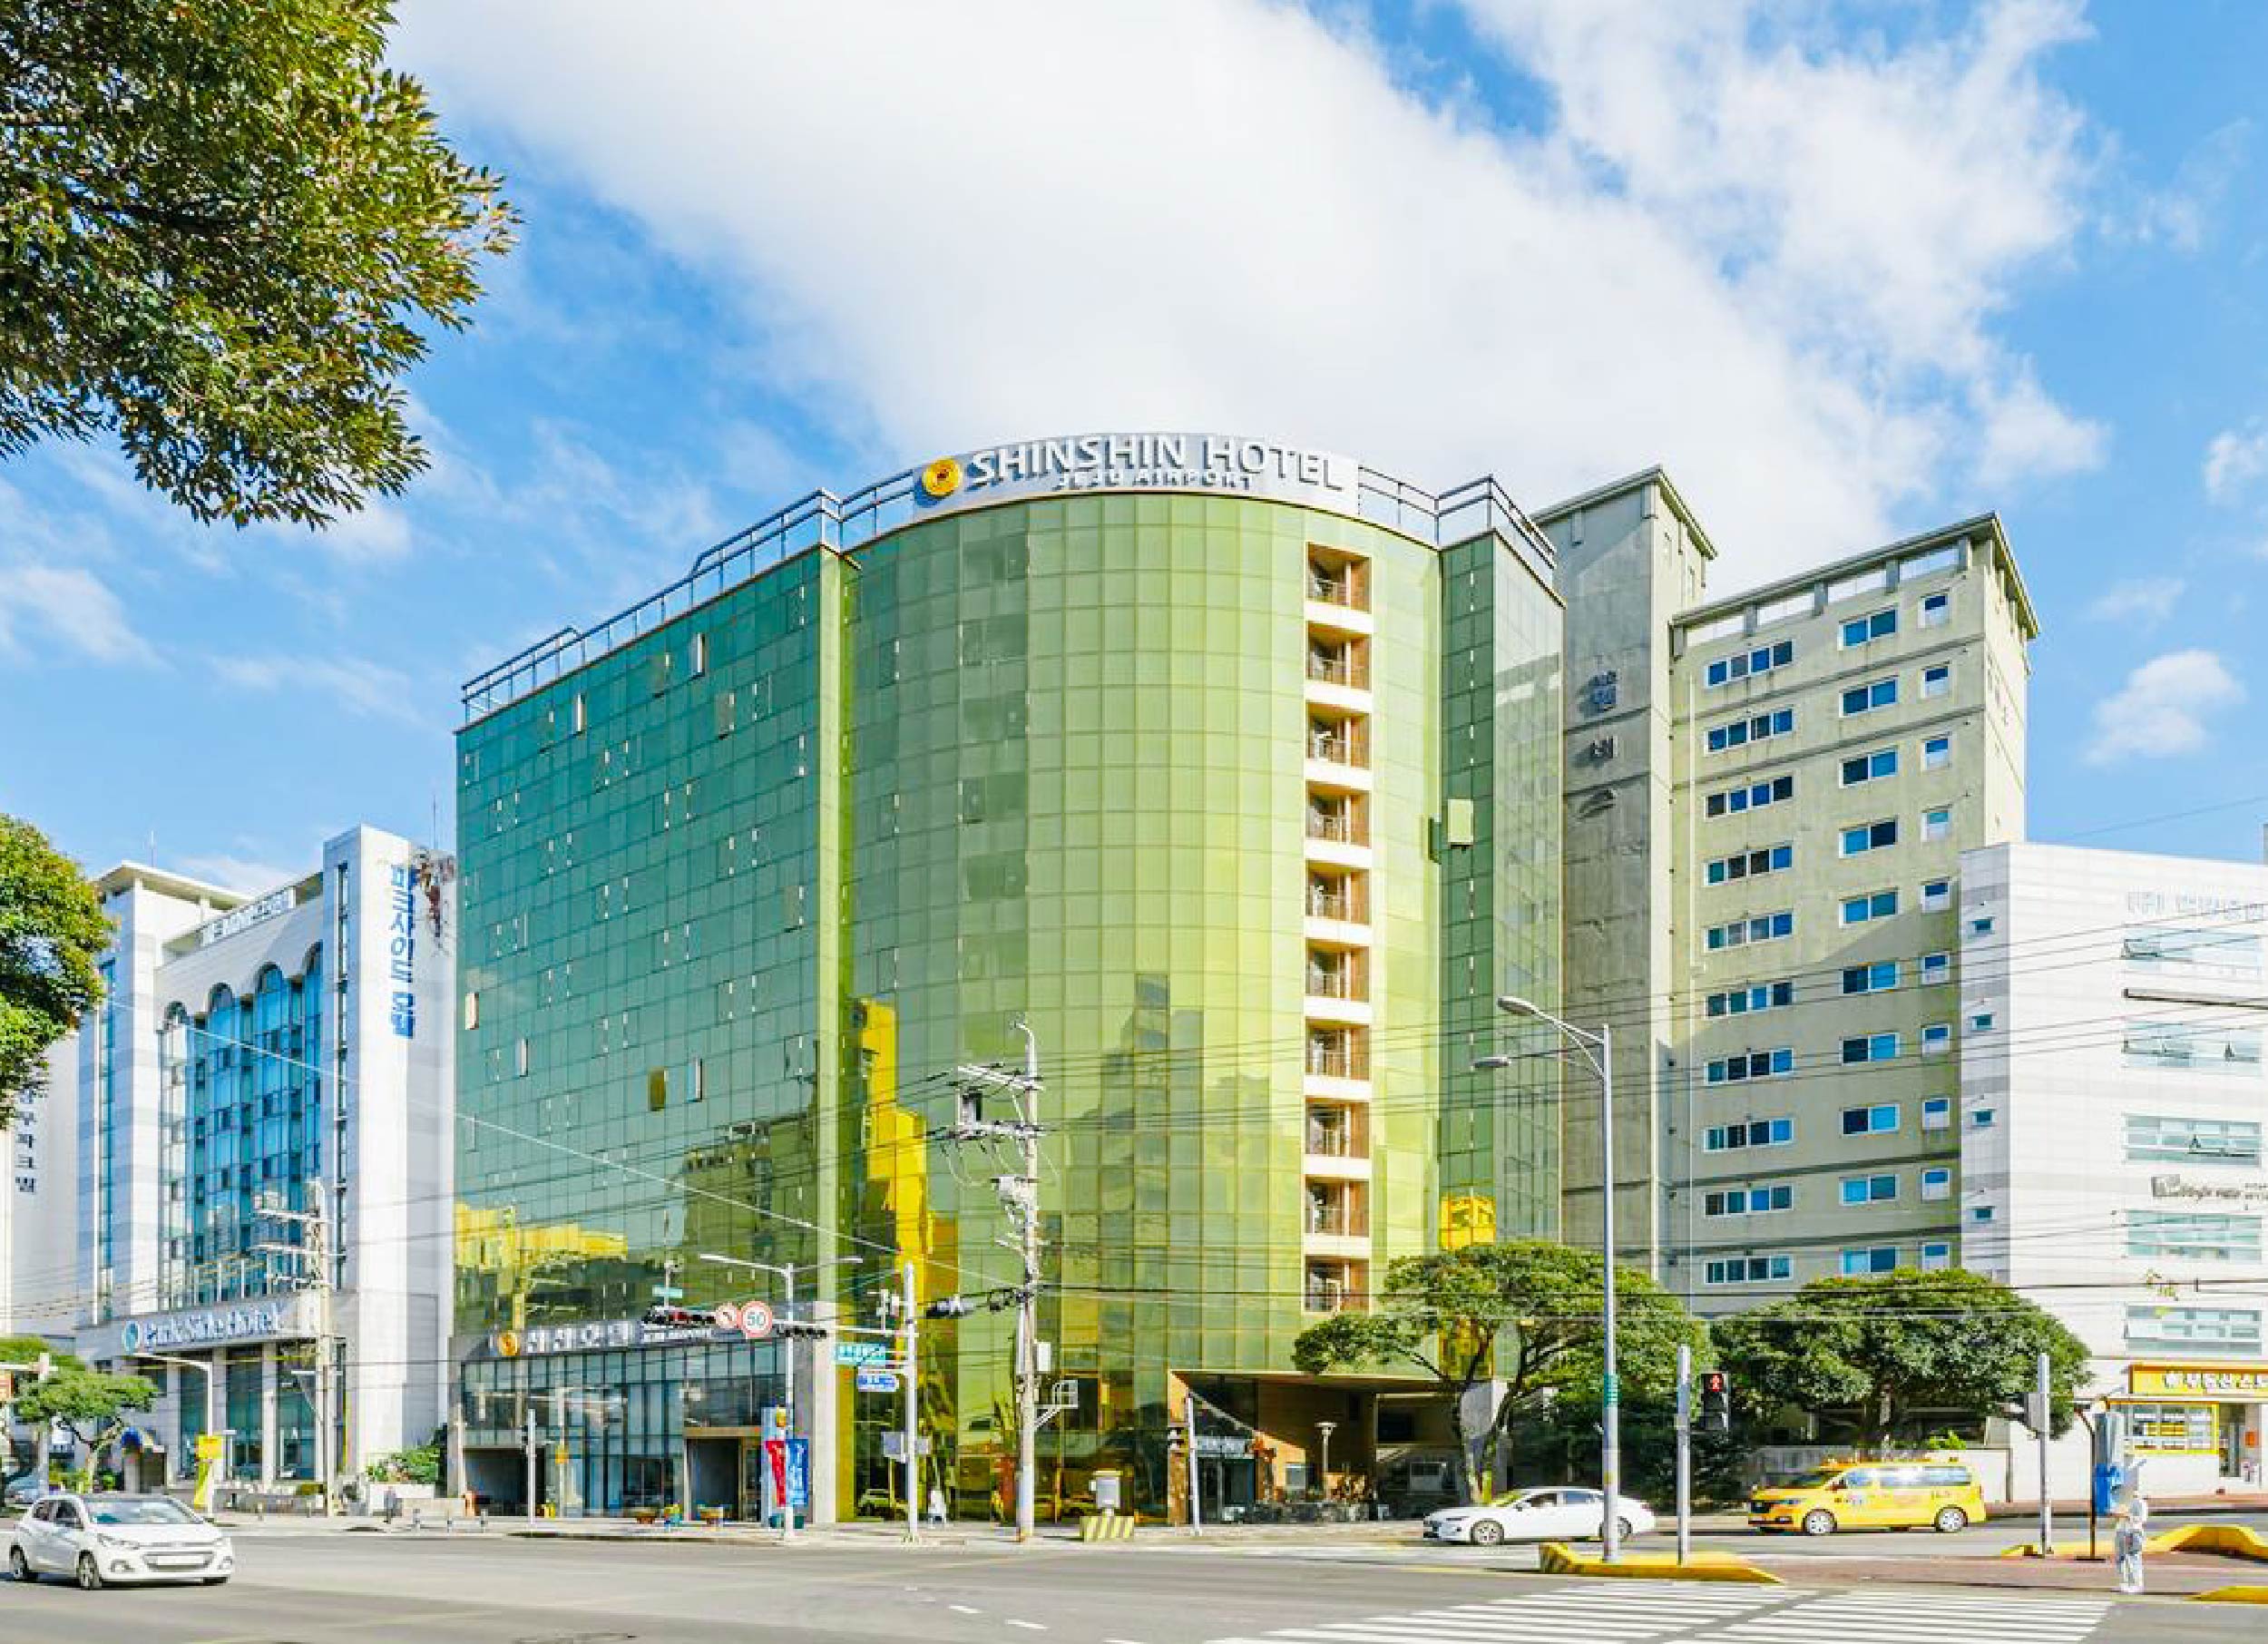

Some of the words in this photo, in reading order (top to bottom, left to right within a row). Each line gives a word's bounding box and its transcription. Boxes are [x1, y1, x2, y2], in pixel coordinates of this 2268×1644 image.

[969, 434, 1186, 484] SHINSHIN
[1205, 435, 1344, 491] HOTEL
[1134, 469, 1254, 491] AIRPORT
[747, 1311, 766, 1326] 50
